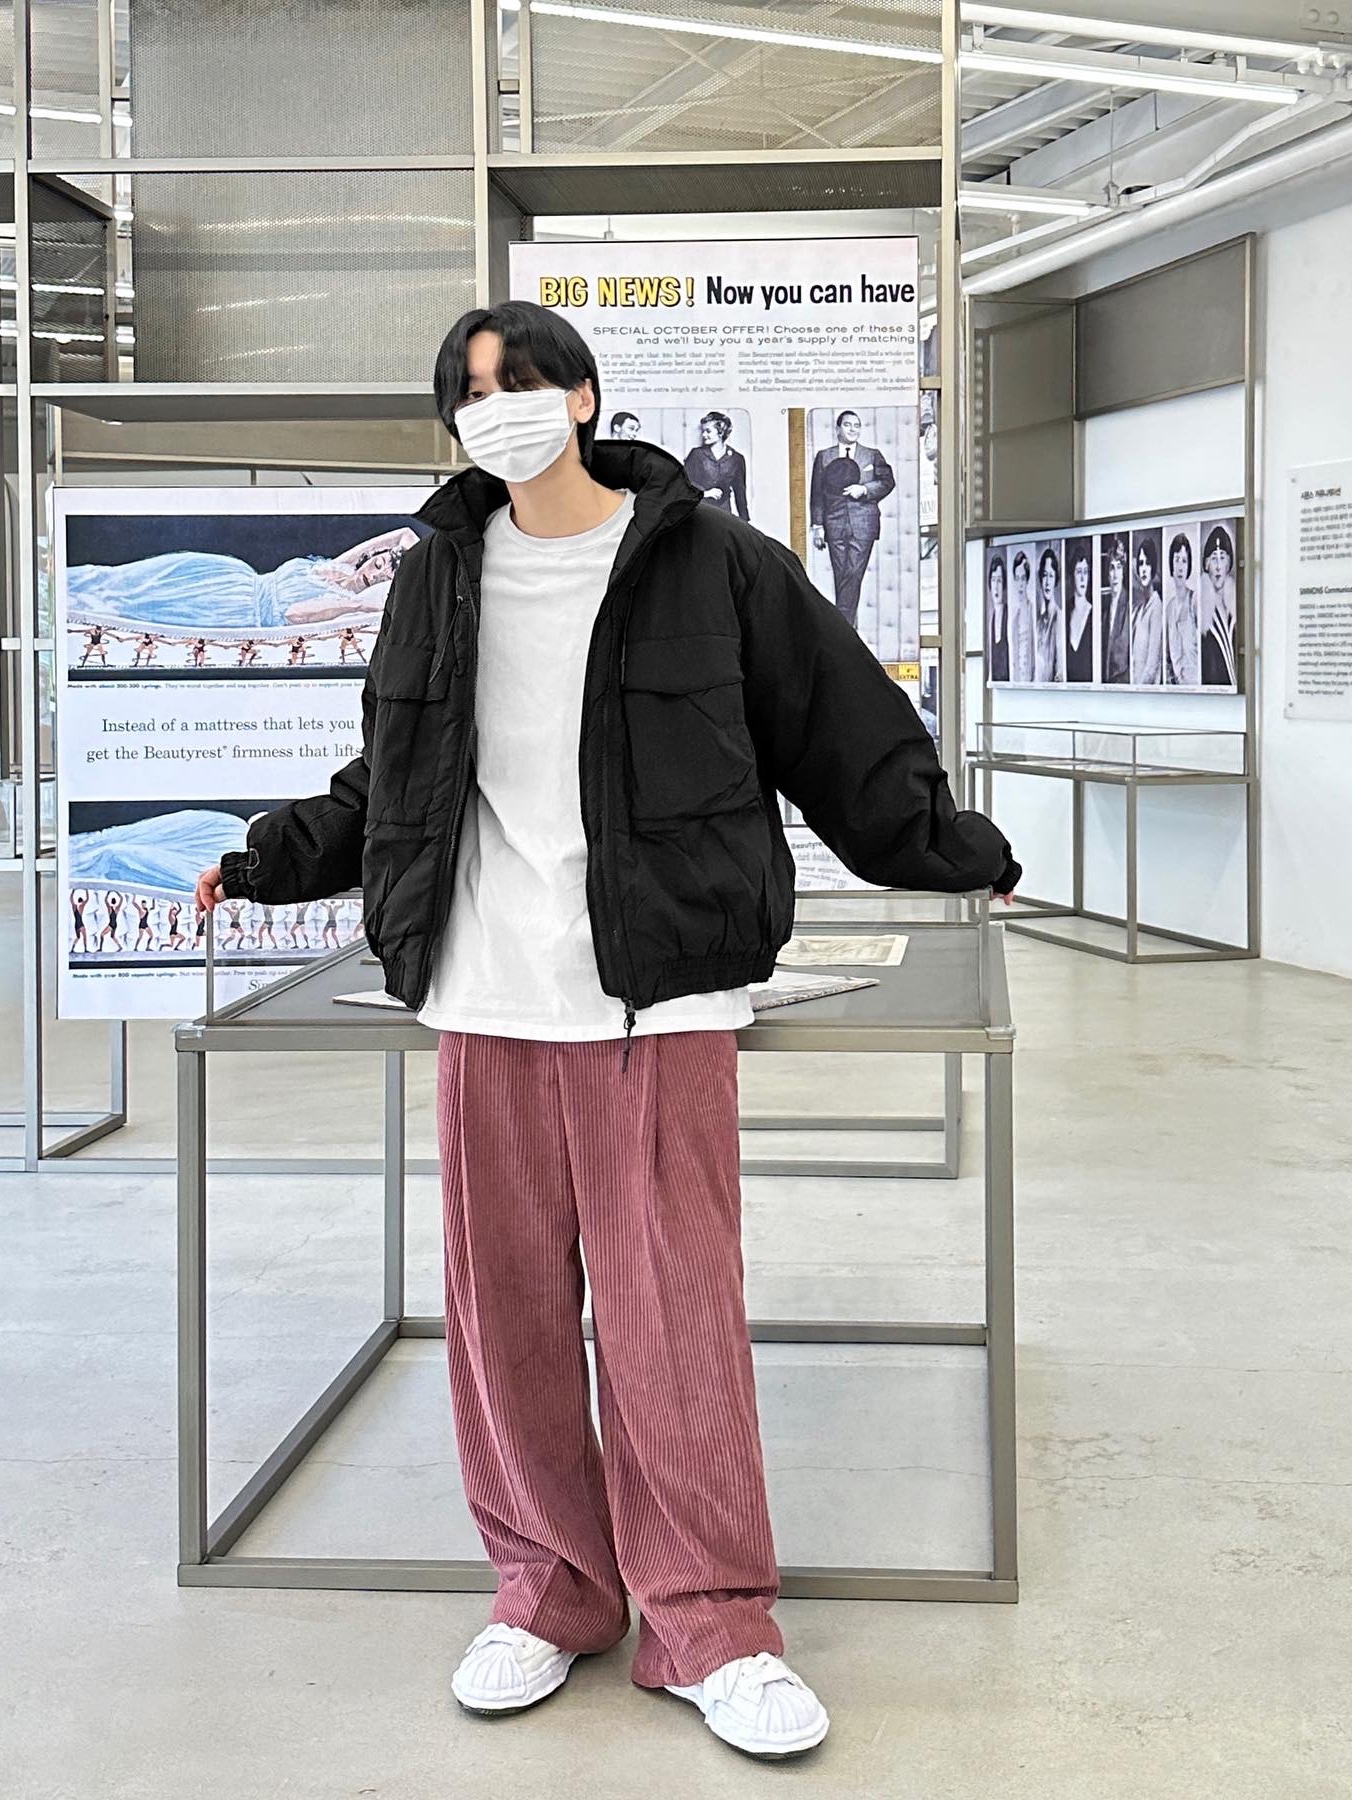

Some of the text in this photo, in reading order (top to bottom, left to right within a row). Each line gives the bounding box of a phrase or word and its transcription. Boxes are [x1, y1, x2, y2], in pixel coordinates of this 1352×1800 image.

[540, 274, 915, 310] BIG NEWS! Now you can have
[593, 326, 649, 335] SPECIAL
[653, 326, 718, 335] OCTOBER
[722, 325, 770, 334] OFFER!
[773, 325, 821, 334] Choose
[852, 325, 865, 333] of
[869, 325, 903, 333] these
[907, 324, 915, 333] 3
[636, 337, 659, 345] and
[664, 336, 689, 345] we'll
[693, 336, 715, 347] buy
[720, 338, 741, 346] you
[757, 336, 793, 346] year's
[797, 335, 835, 346] supply
[841, 335, 854, 344] of
[858, 334, 915, 345] matching
[102, 716, 355, 733] Instead of a mattress that lets you
[86, 747, 109, 763] get
[115, 746, 139, 760] the
[232, 744, 293, 758] firmness
[299, 744, 329, 758] that
[334, 743, 362, 757] lifts
